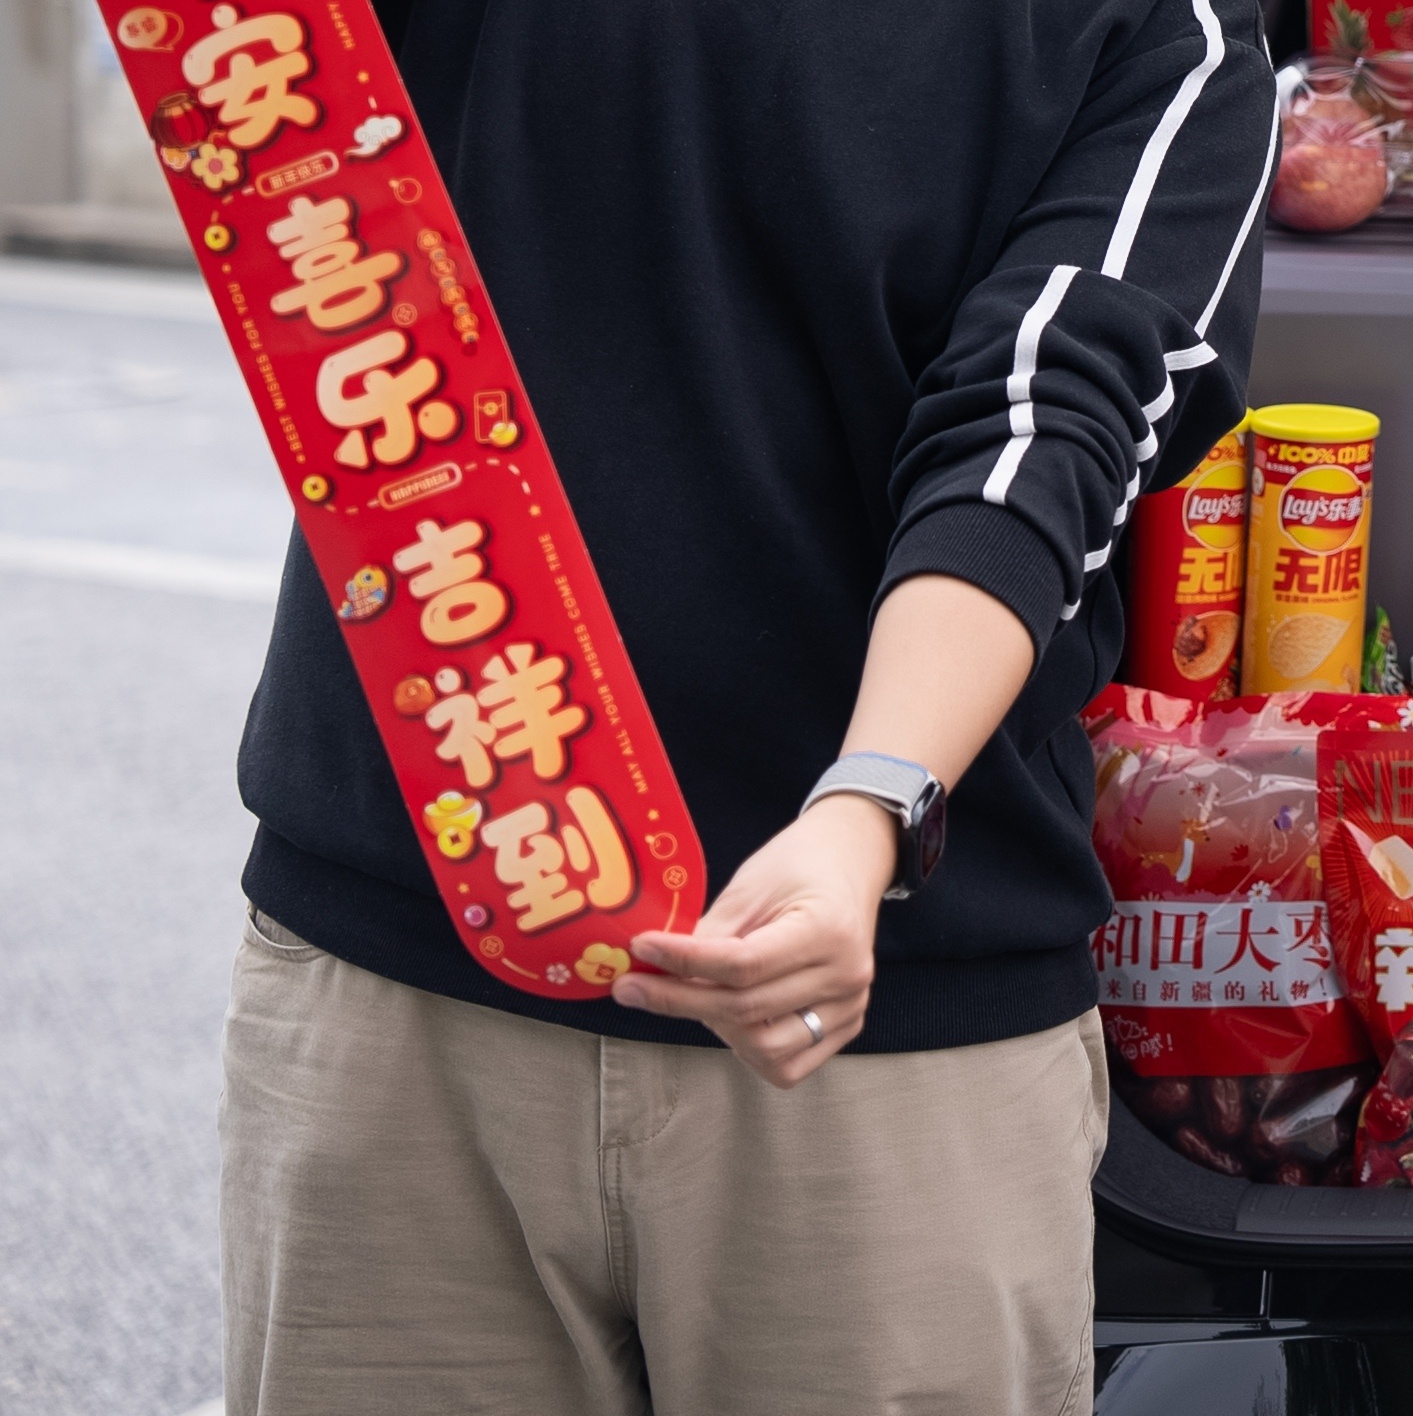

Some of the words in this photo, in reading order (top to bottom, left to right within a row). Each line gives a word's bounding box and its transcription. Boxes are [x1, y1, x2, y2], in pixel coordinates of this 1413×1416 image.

[328, 2, 355, 50] HAPPY
[227, 282, 249, 316] YOU
[242, 319, 263, 350] FOR
[256, 353, 287, 411] WISHES
[279, 415, 303, 452] BEST
[538, 533, 561, 571] TRUE
[1273, 546, 1363, 594] 无限
[554, 575, 581, 620] COME
[574, 624, 603, 680] WISHES
[598, 684, 621, 725] YOUR
[615, 729, 634, 756] ALL
[627, 762, 649, 795] MAY
[1092, 906, 1331, 974] 和田大枣
